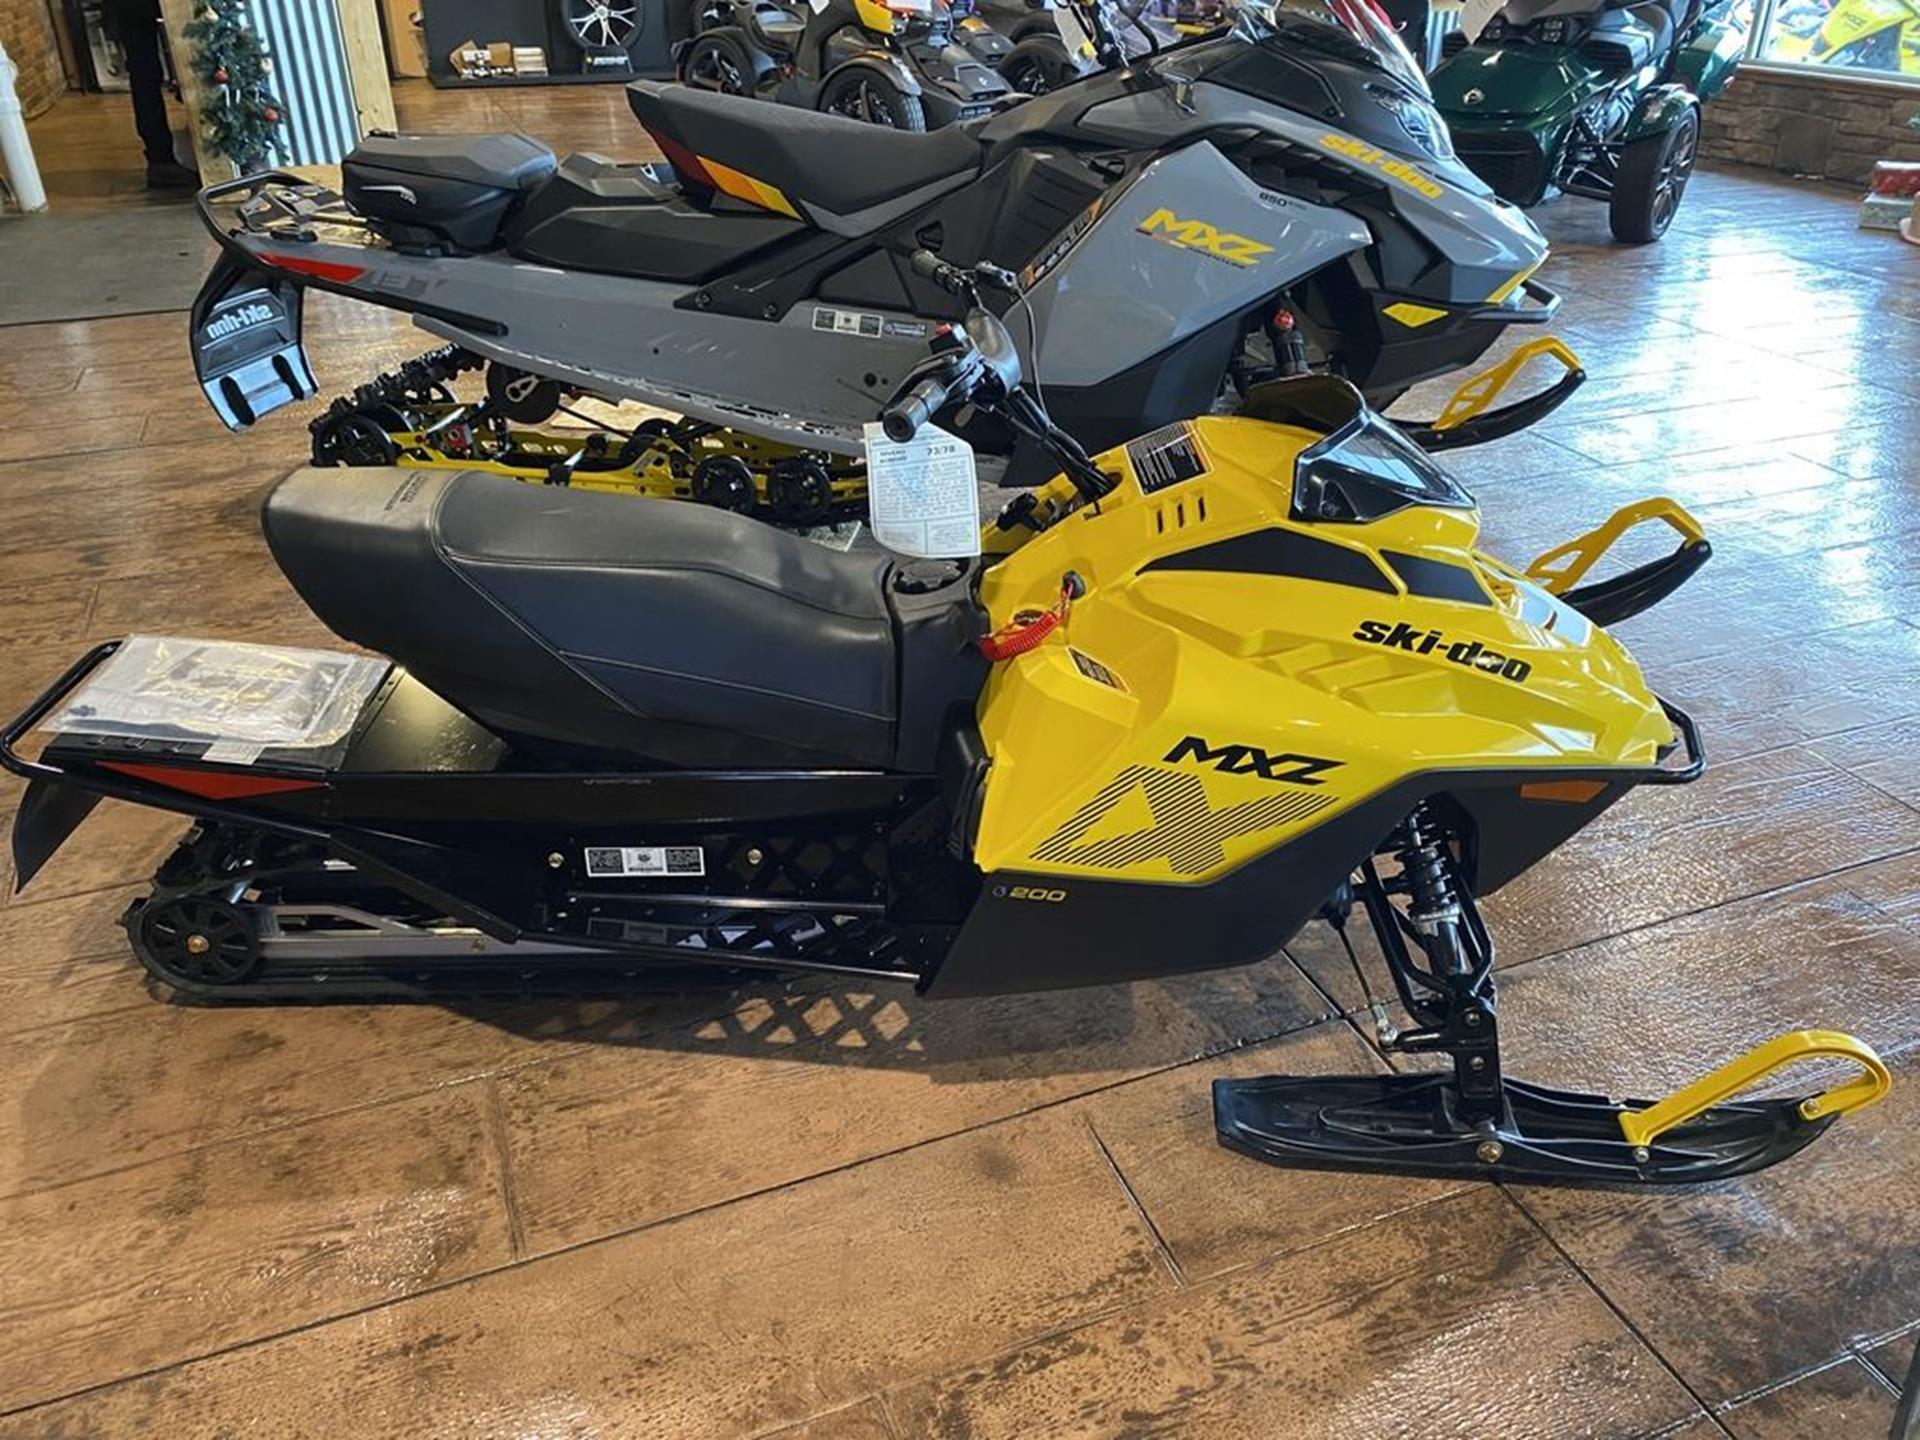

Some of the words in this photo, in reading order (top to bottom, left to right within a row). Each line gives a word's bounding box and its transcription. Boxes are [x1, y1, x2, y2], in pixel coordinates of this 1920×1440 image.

[1139, 207, 1276, 267] MXZ
[1352, 620, 1532, 683] ski-doo
[1161, 735, 1348, 786] MXZ
[1008, 886, 1067, 902] 200
